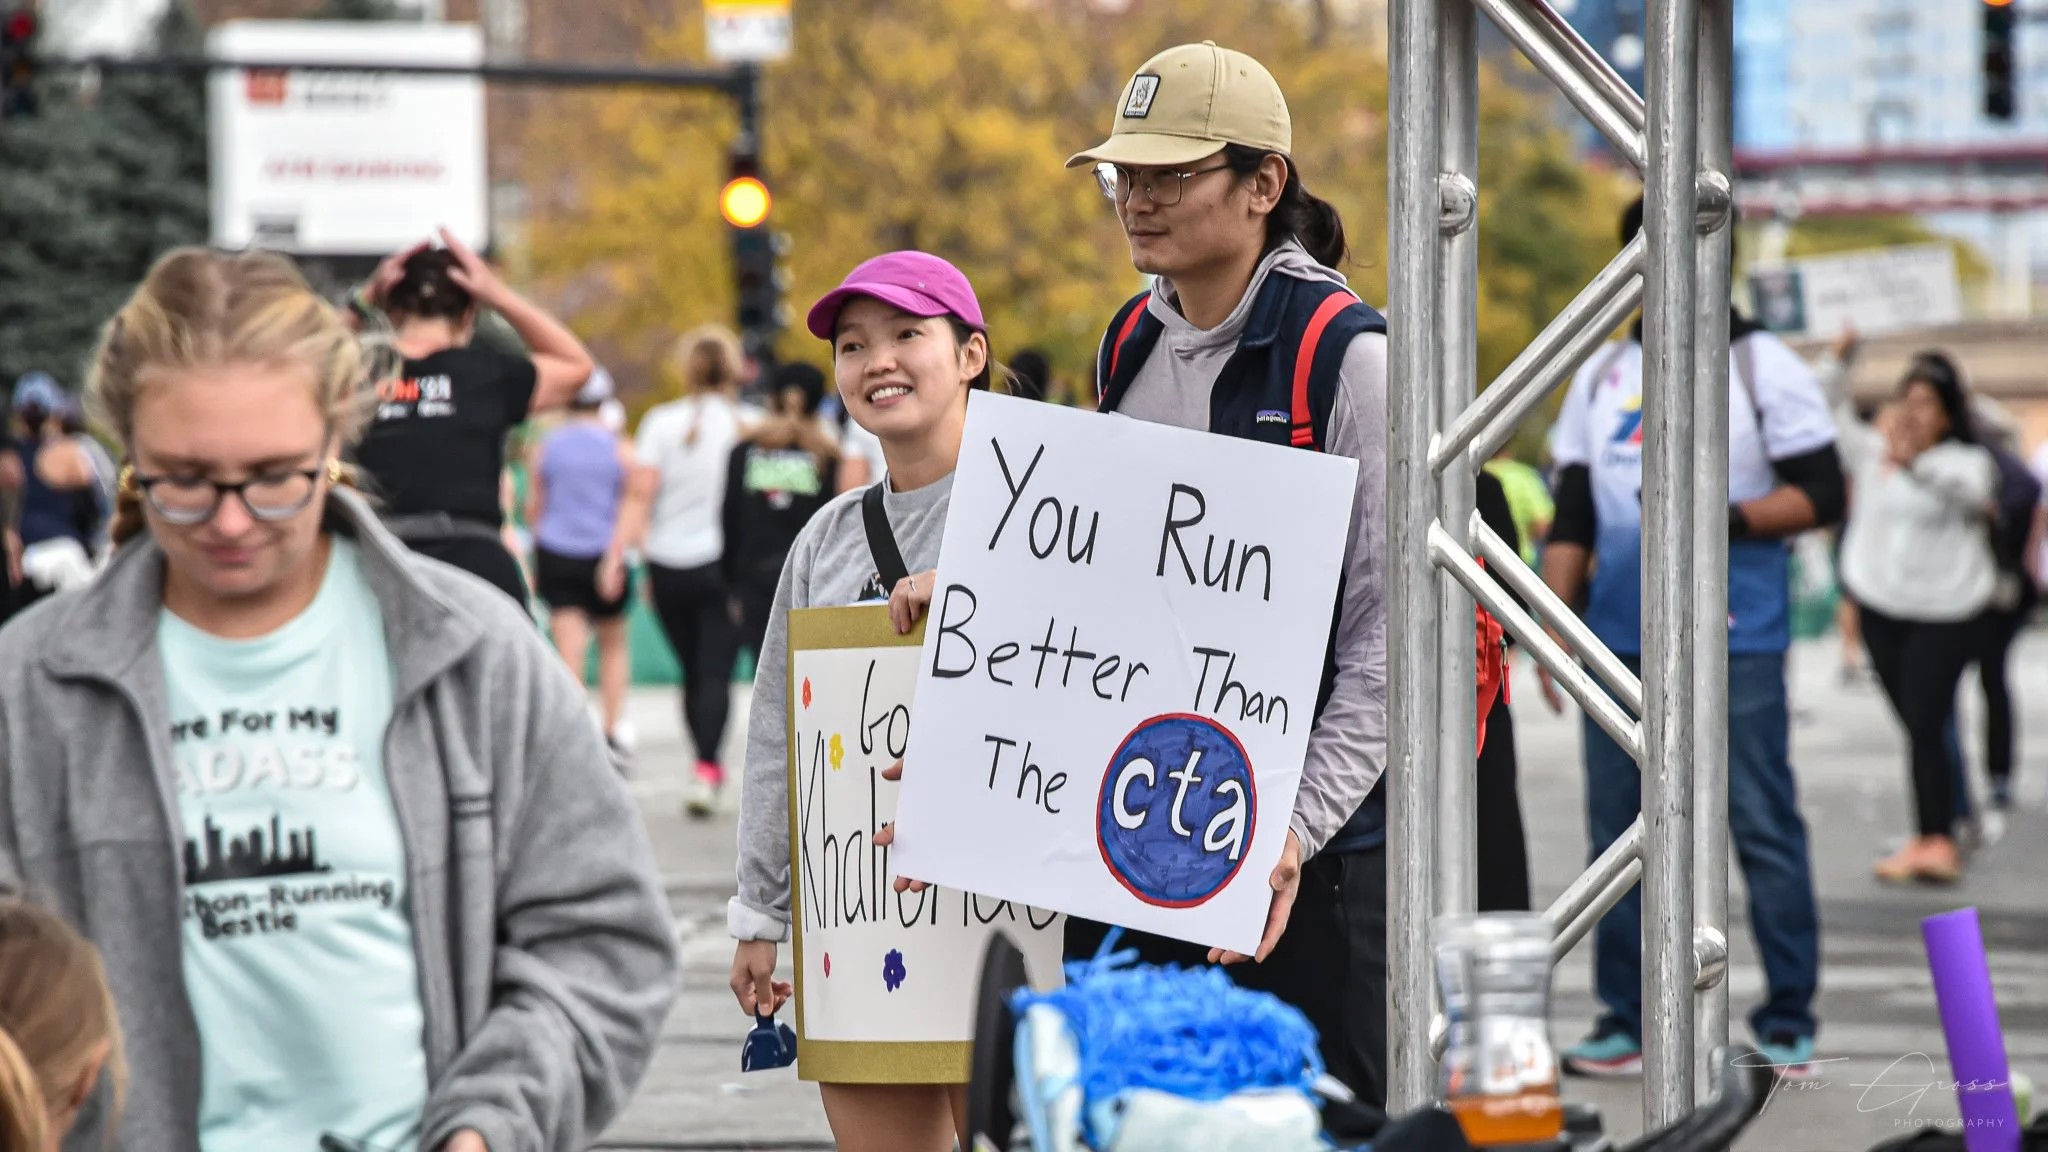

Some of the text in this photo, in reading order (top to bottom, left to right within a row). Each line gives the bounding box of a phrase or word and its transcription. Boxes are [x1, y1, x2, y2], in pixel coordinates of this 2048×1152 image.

[988, 437, 1271, 601] You Run
[221, 707, 277, 733] For
[288, 706, 340, 737] My
[931, 584, 1289, 735] Better Than
[984, 734, 1249, 862] The cta
[184, 878, 394, 917] hon-Running
